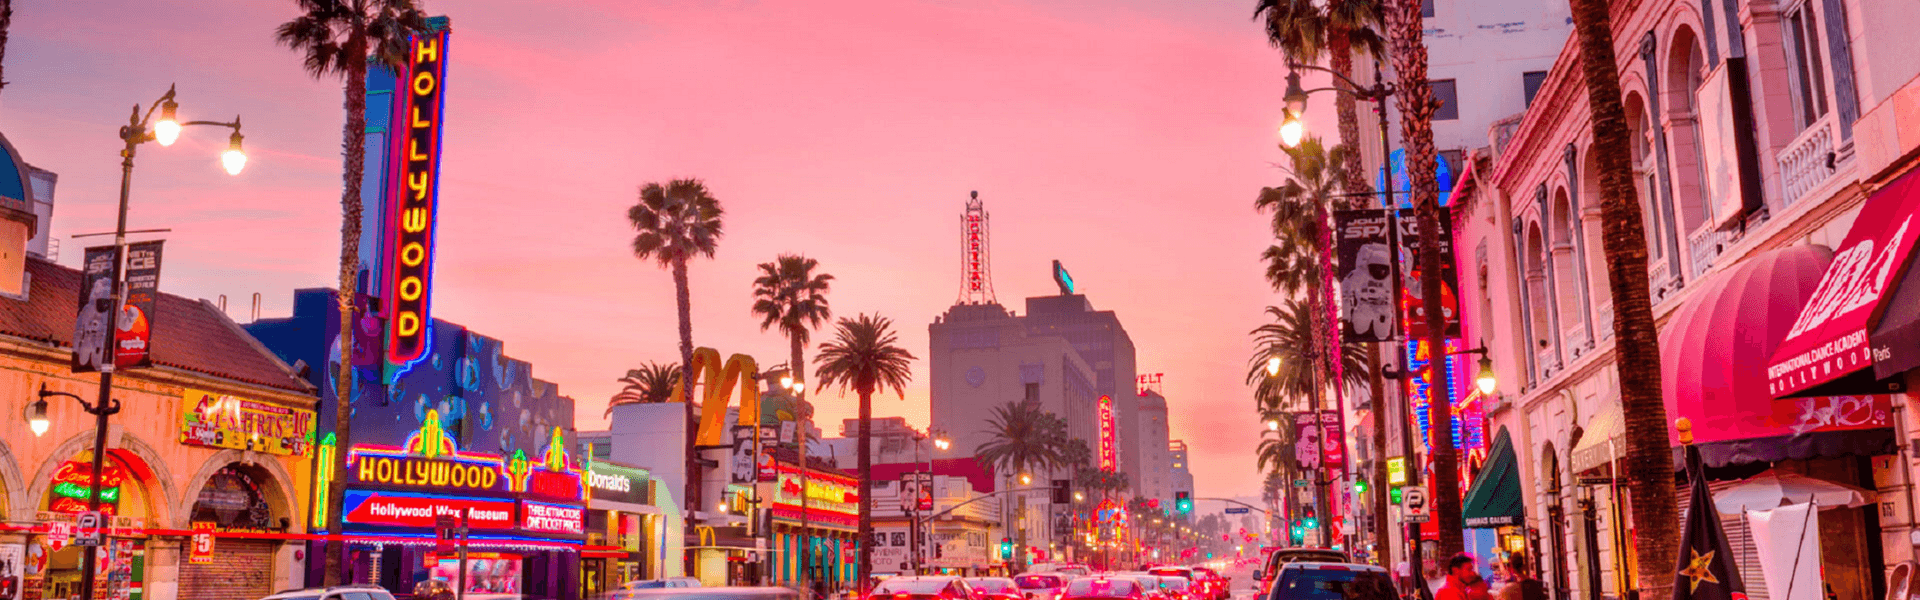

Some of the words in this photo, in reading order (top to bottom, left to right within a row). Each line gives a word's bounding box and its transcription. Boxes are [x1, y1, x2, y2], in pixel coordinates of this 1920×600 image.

[398, 38, 438, 337] HOLLYWOOD
[969, 222, 982, 291] CAPITAN
[1768, 352, 1811, 380] INTERNATIONAL
[1810, 341, 1834, 363] DANCE
[1833, 328, 1868, 355] ACADEMY
[1769, 346, 1871, 396] HOLLYWOOD
[1873, 344, 1892, 362] Paris
[1101, 412, 1111, 470] CAPITA
[358, 456, 498, 489] HOLLYWOOD
[369, 502, 433, 519] Hollywood
[435, 505, 460, 518] Wax
[467, 507, 509, 521] Museum
